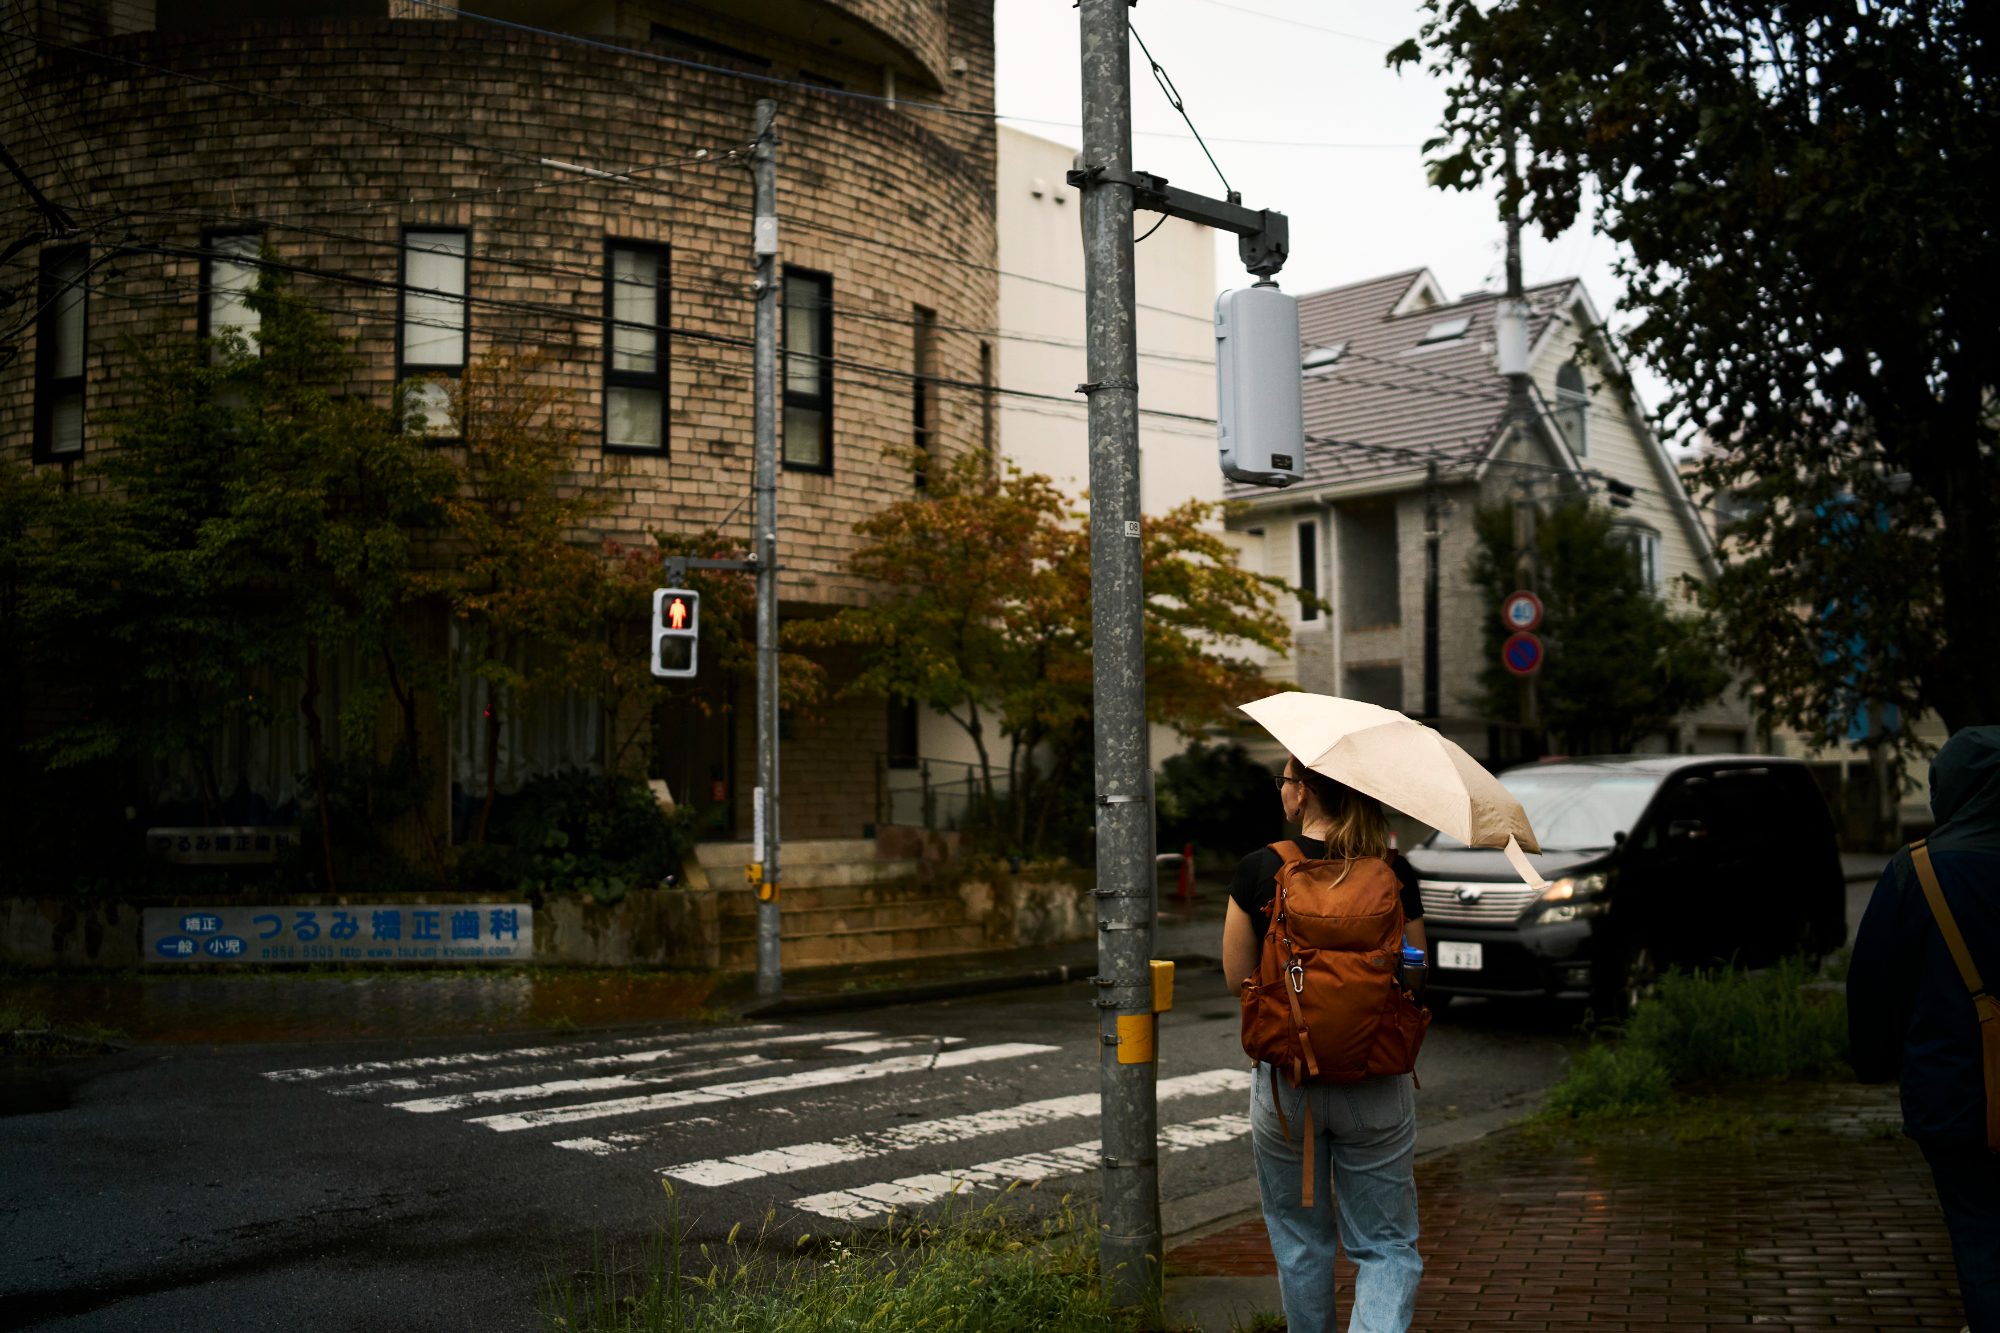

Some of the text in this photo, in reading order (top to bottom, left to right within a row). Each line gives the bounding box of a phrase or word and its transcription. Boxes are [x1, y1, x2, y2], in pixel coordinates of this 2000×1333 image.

[1513, 602, 1532, 620] 40
[185, 917, 216, 931] 矯正
[252, 909, 520, 941] つるみ矯正歯科
[162, 939, 193, 953] 一般
[209, 939, 240, 953] 小児
